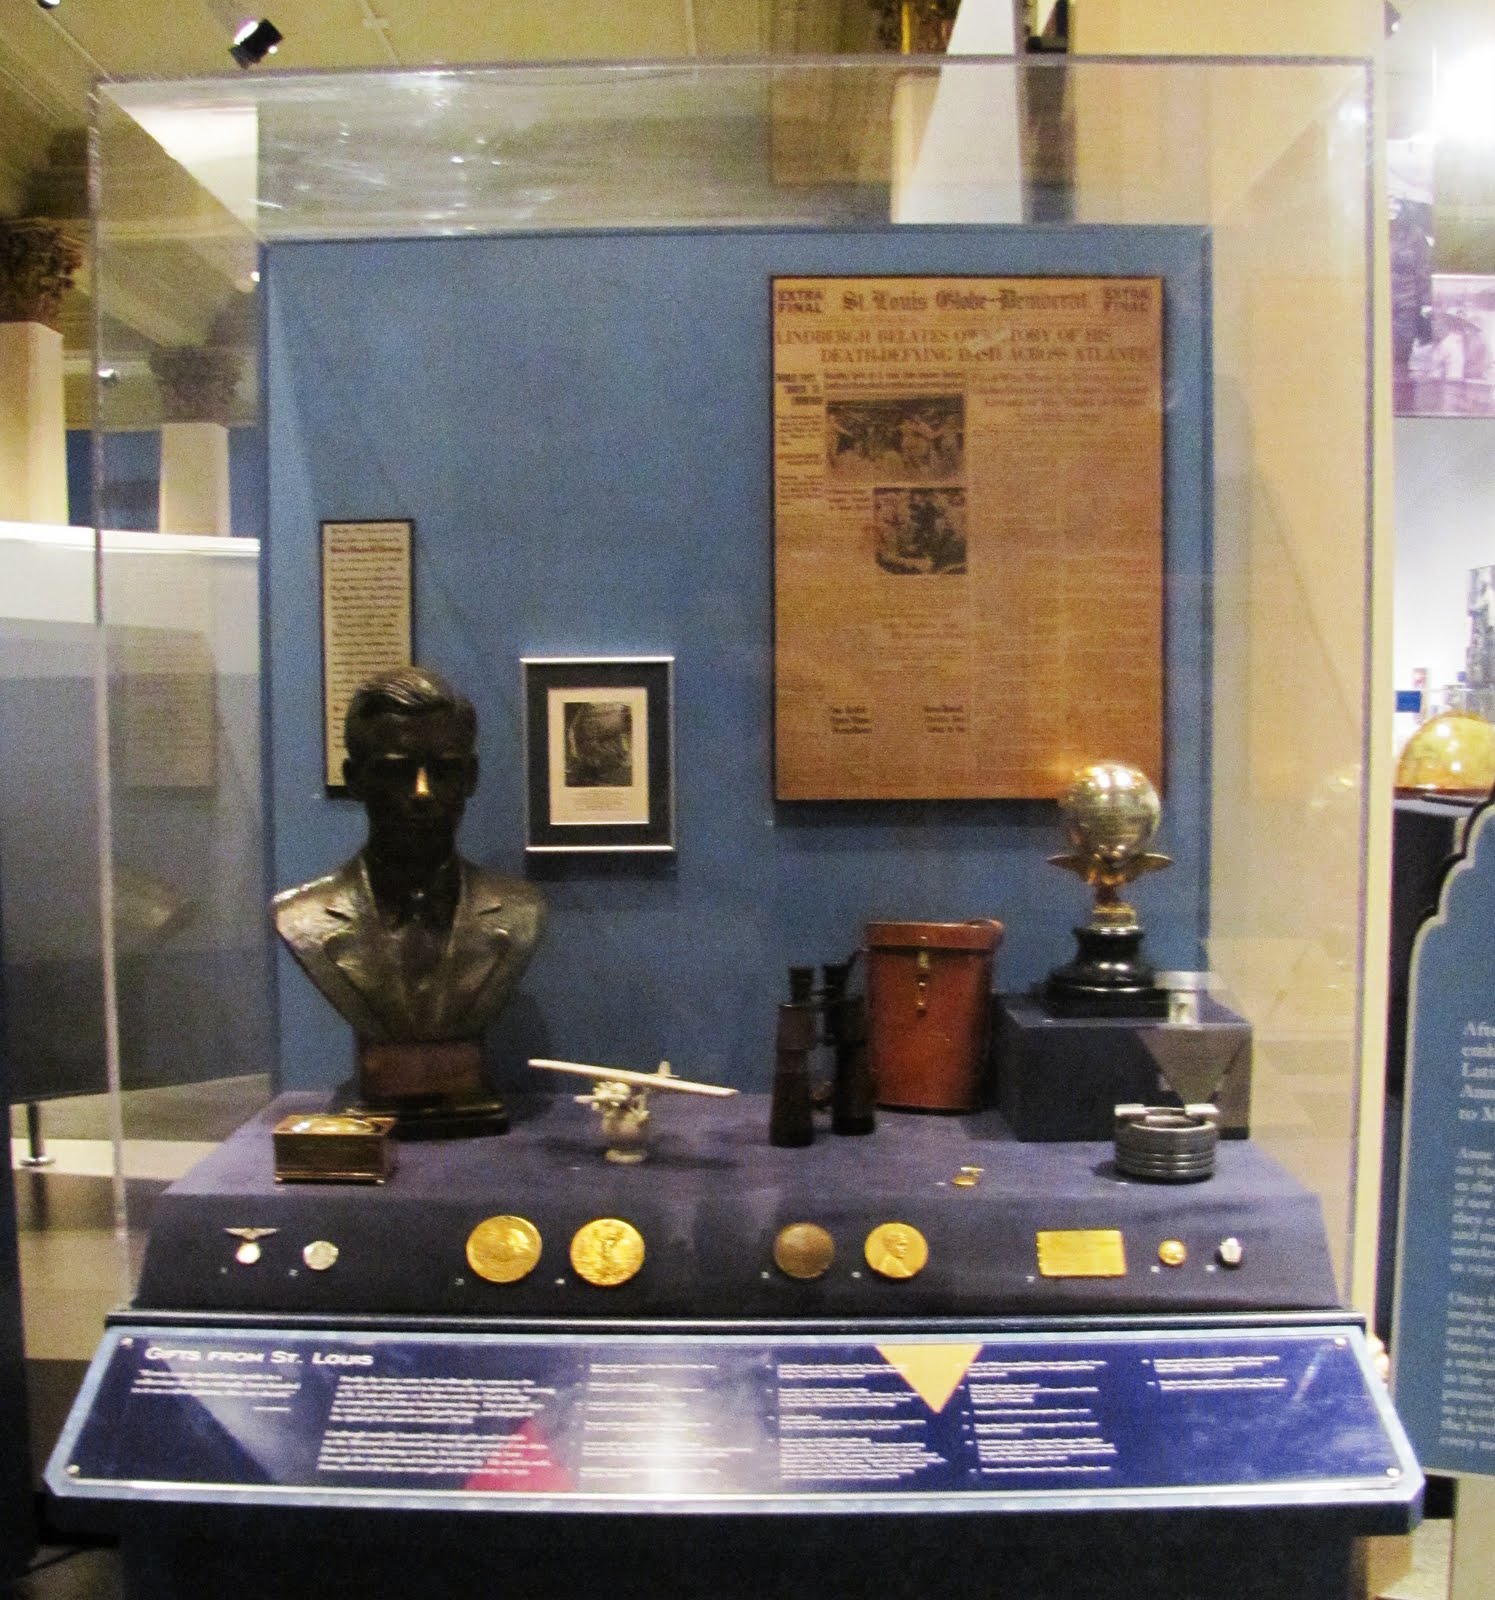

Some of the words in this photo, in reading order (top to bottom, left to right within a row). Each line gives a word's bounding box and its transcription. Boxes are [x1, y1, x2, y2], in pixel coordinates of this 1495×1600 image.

[872, 289, 928, 311] Louis
[144, 1346, 202, 1362] GIFTS
[207, 1350, 265, 1363] FROM
[311, 1352, 374, 1366] LOUIS
